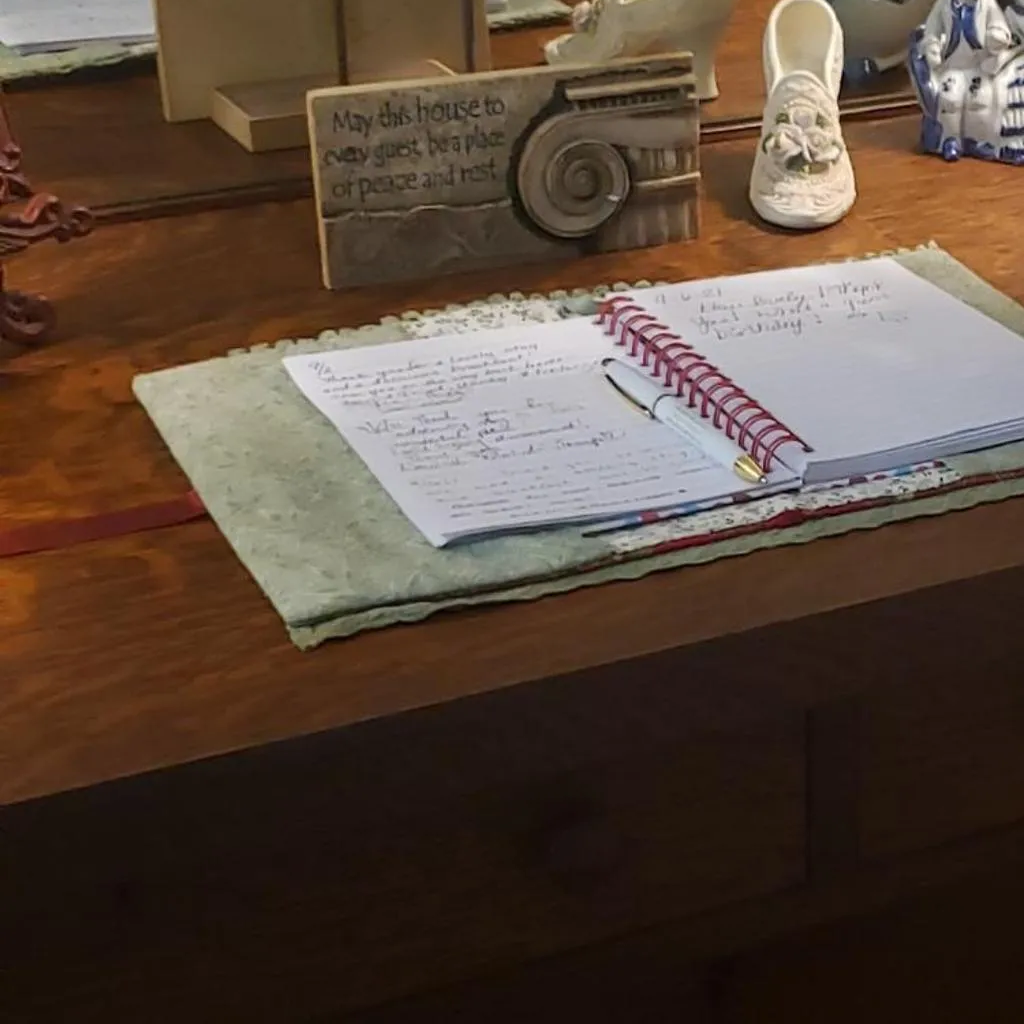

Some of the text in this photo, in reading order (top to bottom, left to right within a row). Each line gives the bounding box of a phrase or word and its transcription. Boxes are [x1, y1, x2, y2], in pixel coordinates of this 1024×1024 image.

[332, 95, 505, 138] May this house to
[374, 137, 423, 168] guest
[427, 129, 449, 155] be
[451, 134, 461, 154] a
[464, 124, 506, 155] place
[331, 157, 497, 203] of peace and rest
